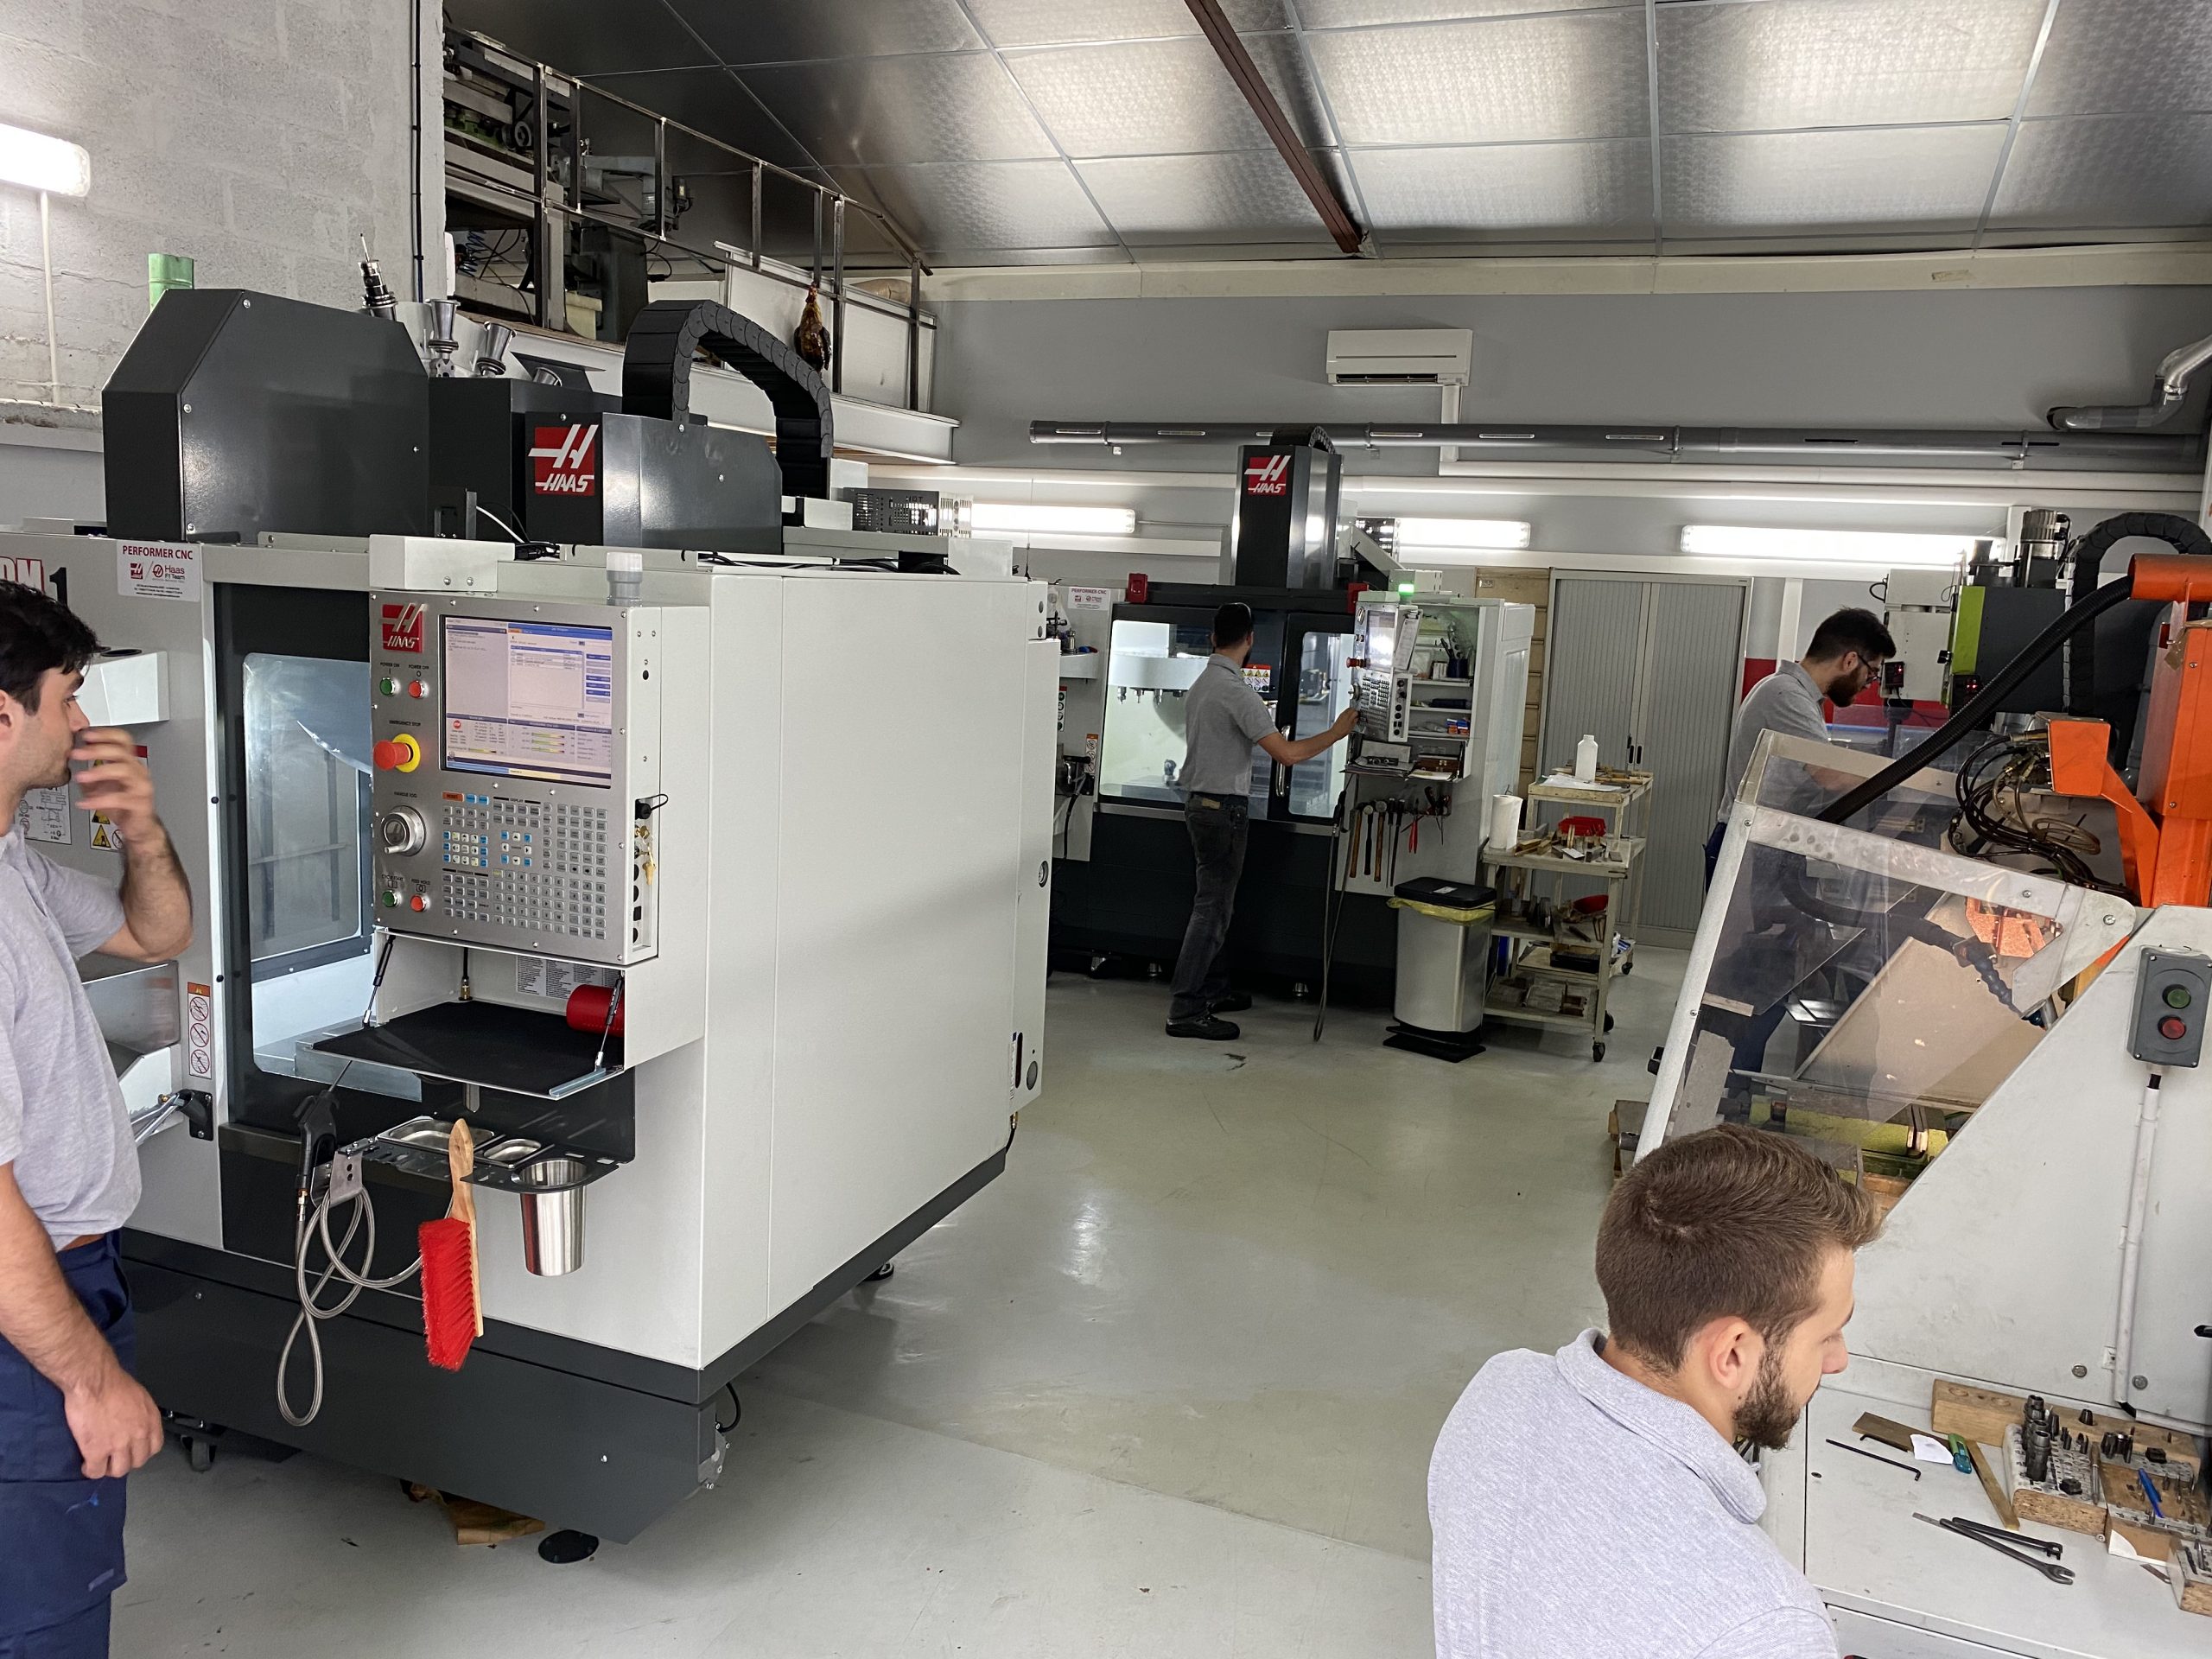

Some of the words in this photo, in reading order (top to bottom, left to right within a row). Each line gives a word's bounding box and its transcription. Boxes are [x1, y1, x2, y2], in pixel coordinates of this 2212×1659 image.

[535, 474, 594, 493] HAAS
[1248, 482, 1287, 493] HAAS
[123, 545, 174, 558] PERFORMER
[175, 550, 194, 560] CNC
[164, 564, 185, 575] Haas
[383, 635, 420, 649] HAAS
